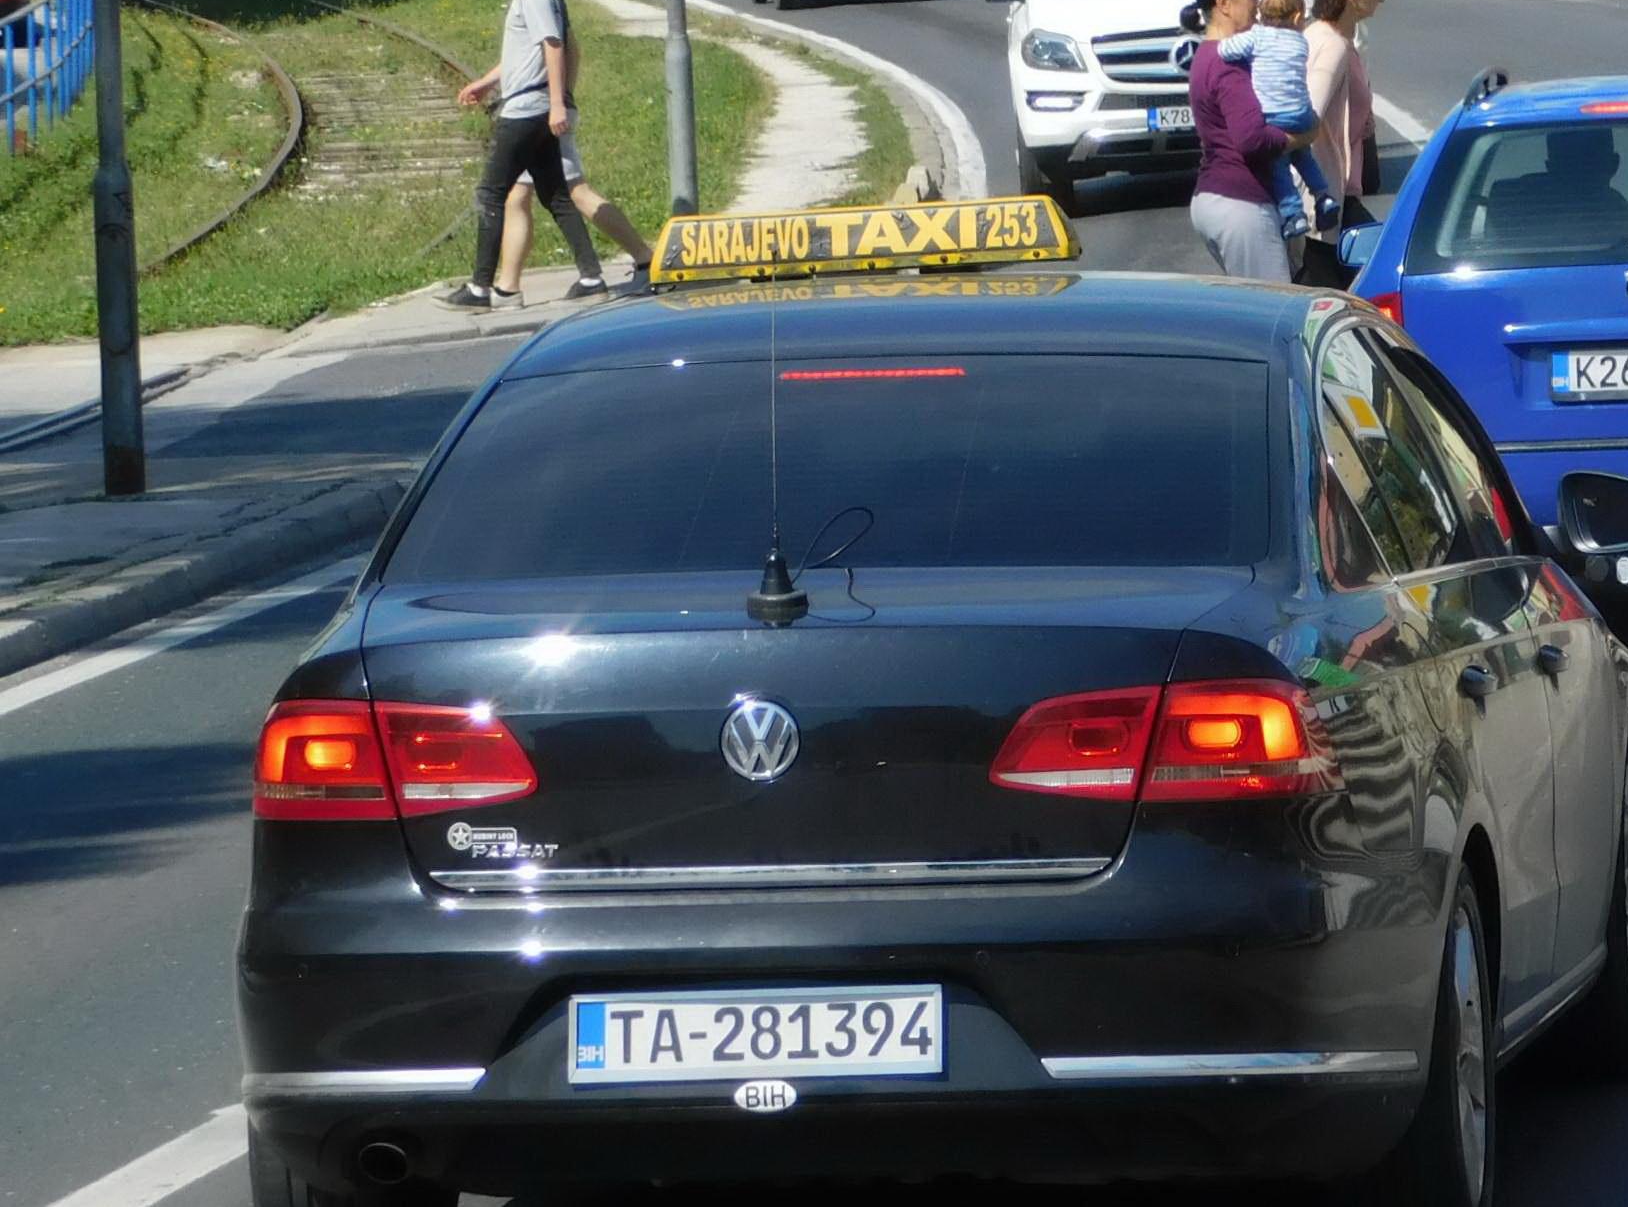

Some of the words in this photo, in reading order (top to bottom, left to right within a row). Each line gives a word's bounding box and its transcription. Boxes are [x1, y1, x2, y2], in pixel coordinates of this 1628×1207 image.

[1160, 109, 1191, 125] K78
[682, 216, 809, 265] SARAJEVO
[816, 206, 979, 257] TAXI
[985, 201, 1039, 248] 253
[472, 844, 559, 858] PASSAT
[610, 1001, 933, 1064] TA-281394
[745, 1086, 786, 1108] BIH
